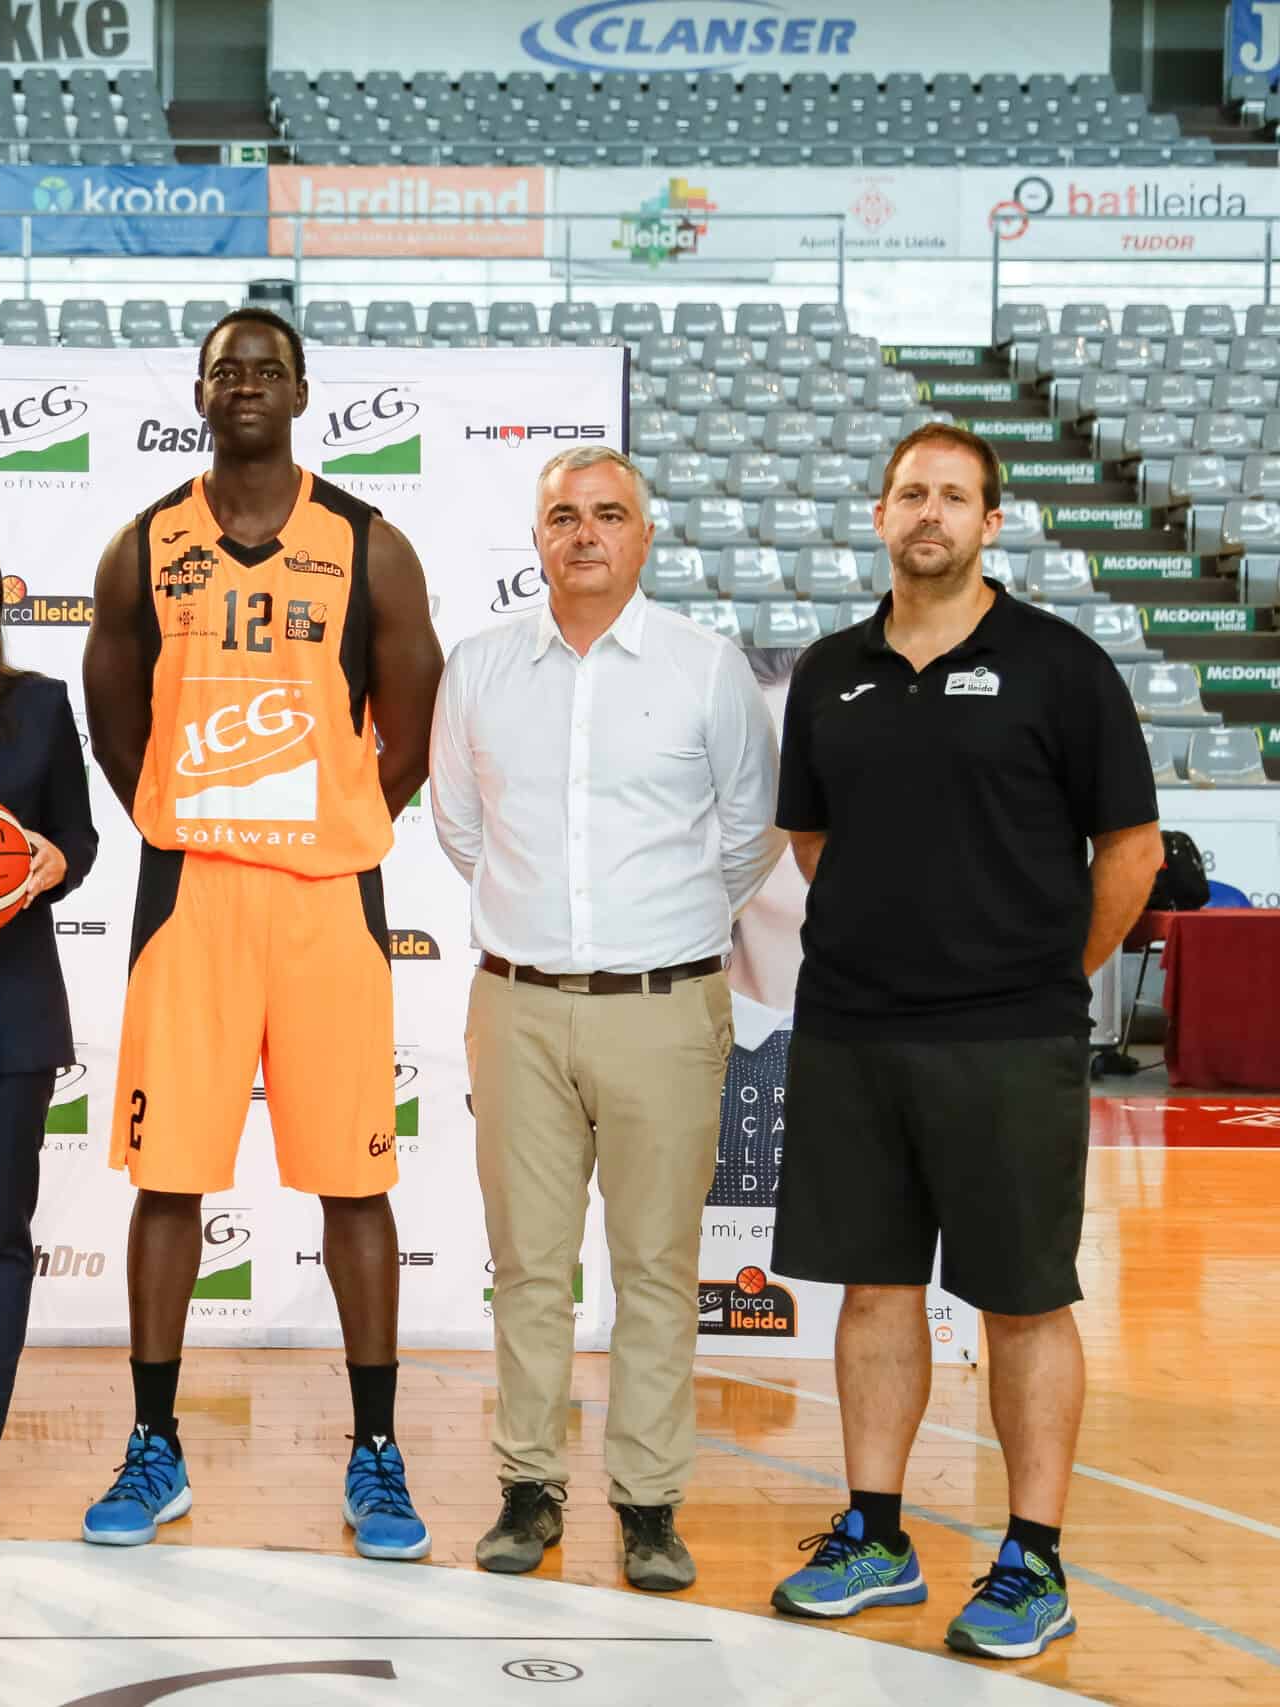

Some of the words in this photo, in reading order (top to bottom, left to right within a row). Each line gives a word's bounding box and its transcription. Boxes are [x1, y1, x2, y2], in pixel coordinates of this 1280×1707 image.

[590, 17, 856, 55] CLANSER
[1241, 4, 1280, 72] J
[83, 178, 226, 215] kroton
[1068, 183, 1248, 217] batlleida
[1121, 234, 1195, 251] TUDOR
[329, 387, 404, 440] ICG
[137, 418, 215, 453] Cash
[1012, 464, 1095, 478] McDonald's
[335, 480, 422, 493] oftware
[1057, 508, 1144, 522] McDonald's
[182, 560, 212, 571] ara
[1102, 556, 1193, 570] McDonald's
[160, 565, 205, 586] lleida
[496, 567, 549, 608] IC
[222, 590, 273, 653] 12
[288, 619, 311, 629] LEB
[1153, 608, 1247, 624] McDonald's
[287, 629, 309, 639] ORO
[184, 688, 295, 766] ICG
[175, 825, 317, 846] Software
[1249, 892, 1280, 908] co
[34, 1244, 106, 1278] hDro
[696, 1291, 718, 1308] CG
[729, 1289, 775, 1312] força
[730, 1310, 788, 1330] lleida
[927, 1305, 953, 1321] cat
